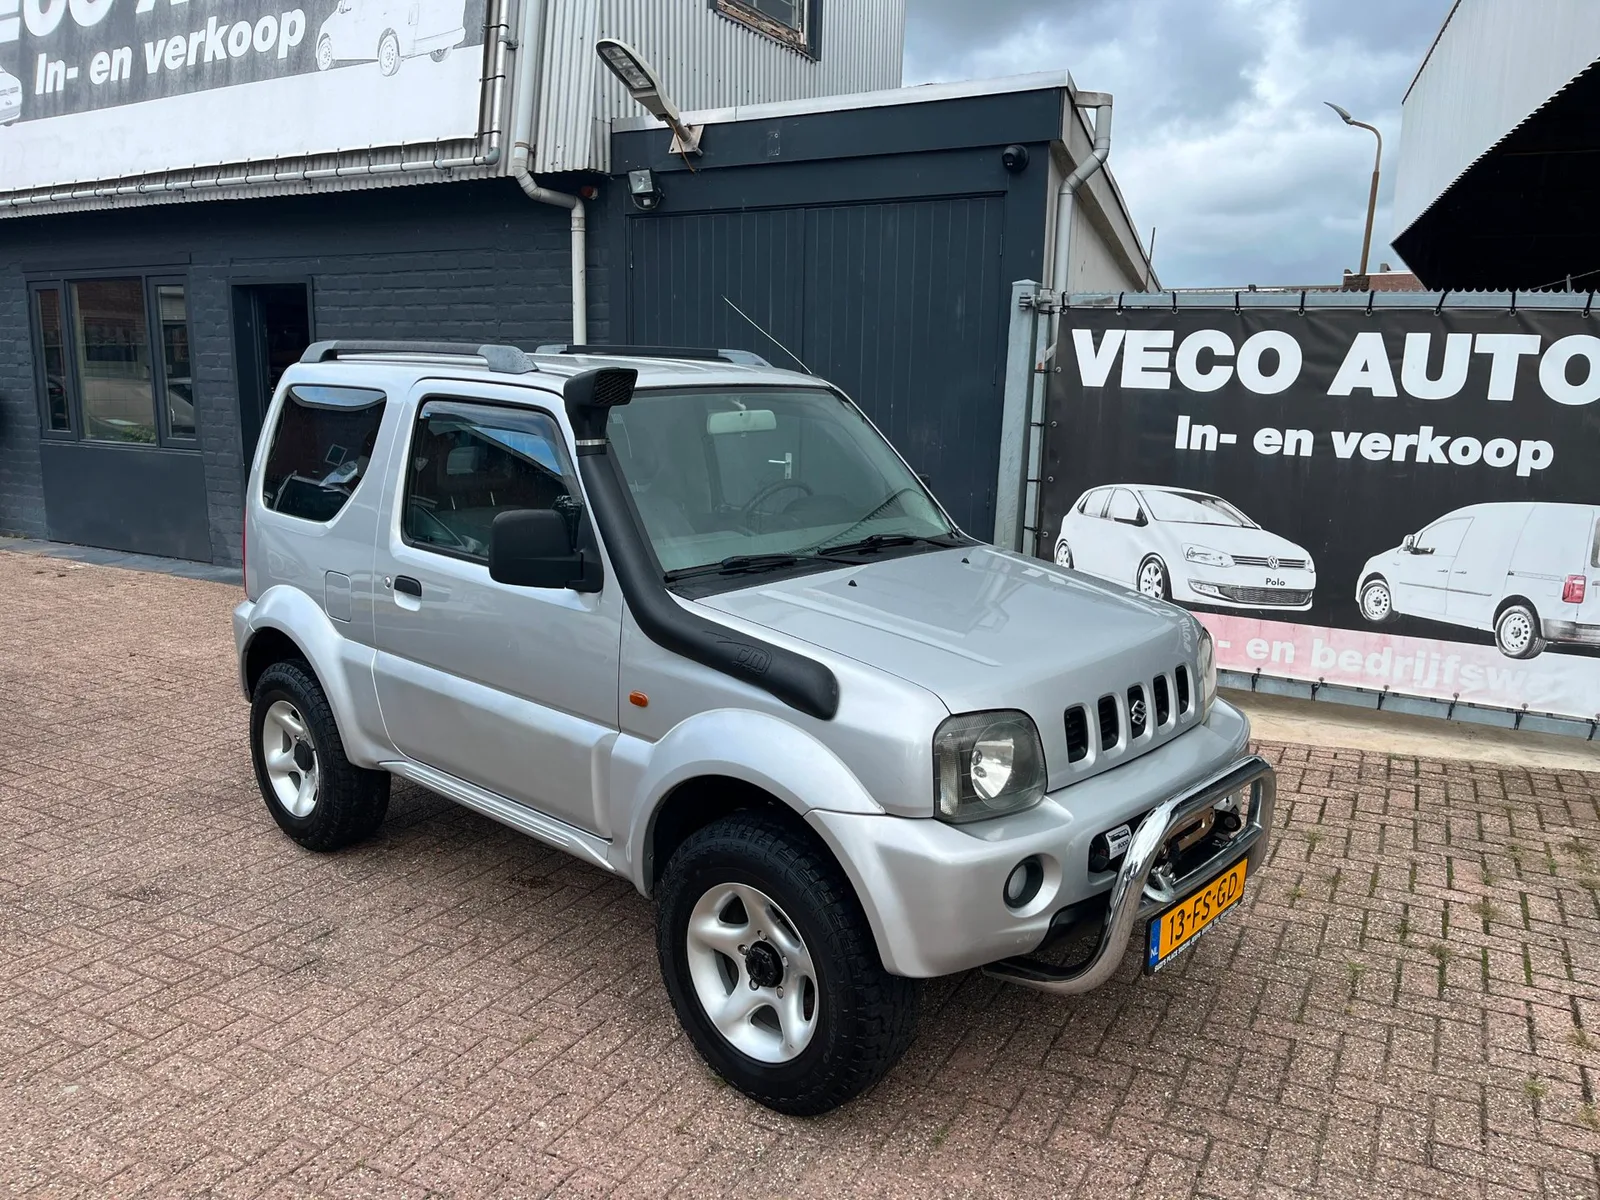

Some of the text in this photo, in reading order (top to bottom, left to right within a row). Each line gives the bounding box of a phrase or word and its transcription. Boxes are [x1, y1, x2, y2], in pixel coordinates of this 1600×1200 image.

[35, 53, 78, 95] In-
[89, 46, 132, 85] en
[144, 8, 306, 74] verkoop
[1072, 328, 1600, 406] VECO AUTO
[1175, 415, 1554, 477] In- en verkoop
[1265, 577, 1286, 586] Polo
[1246, 637, 1295, 664] en
[1169, 872, 1238, 946] 13-FS-GD
[1150, 946, 1159, 959] NL
